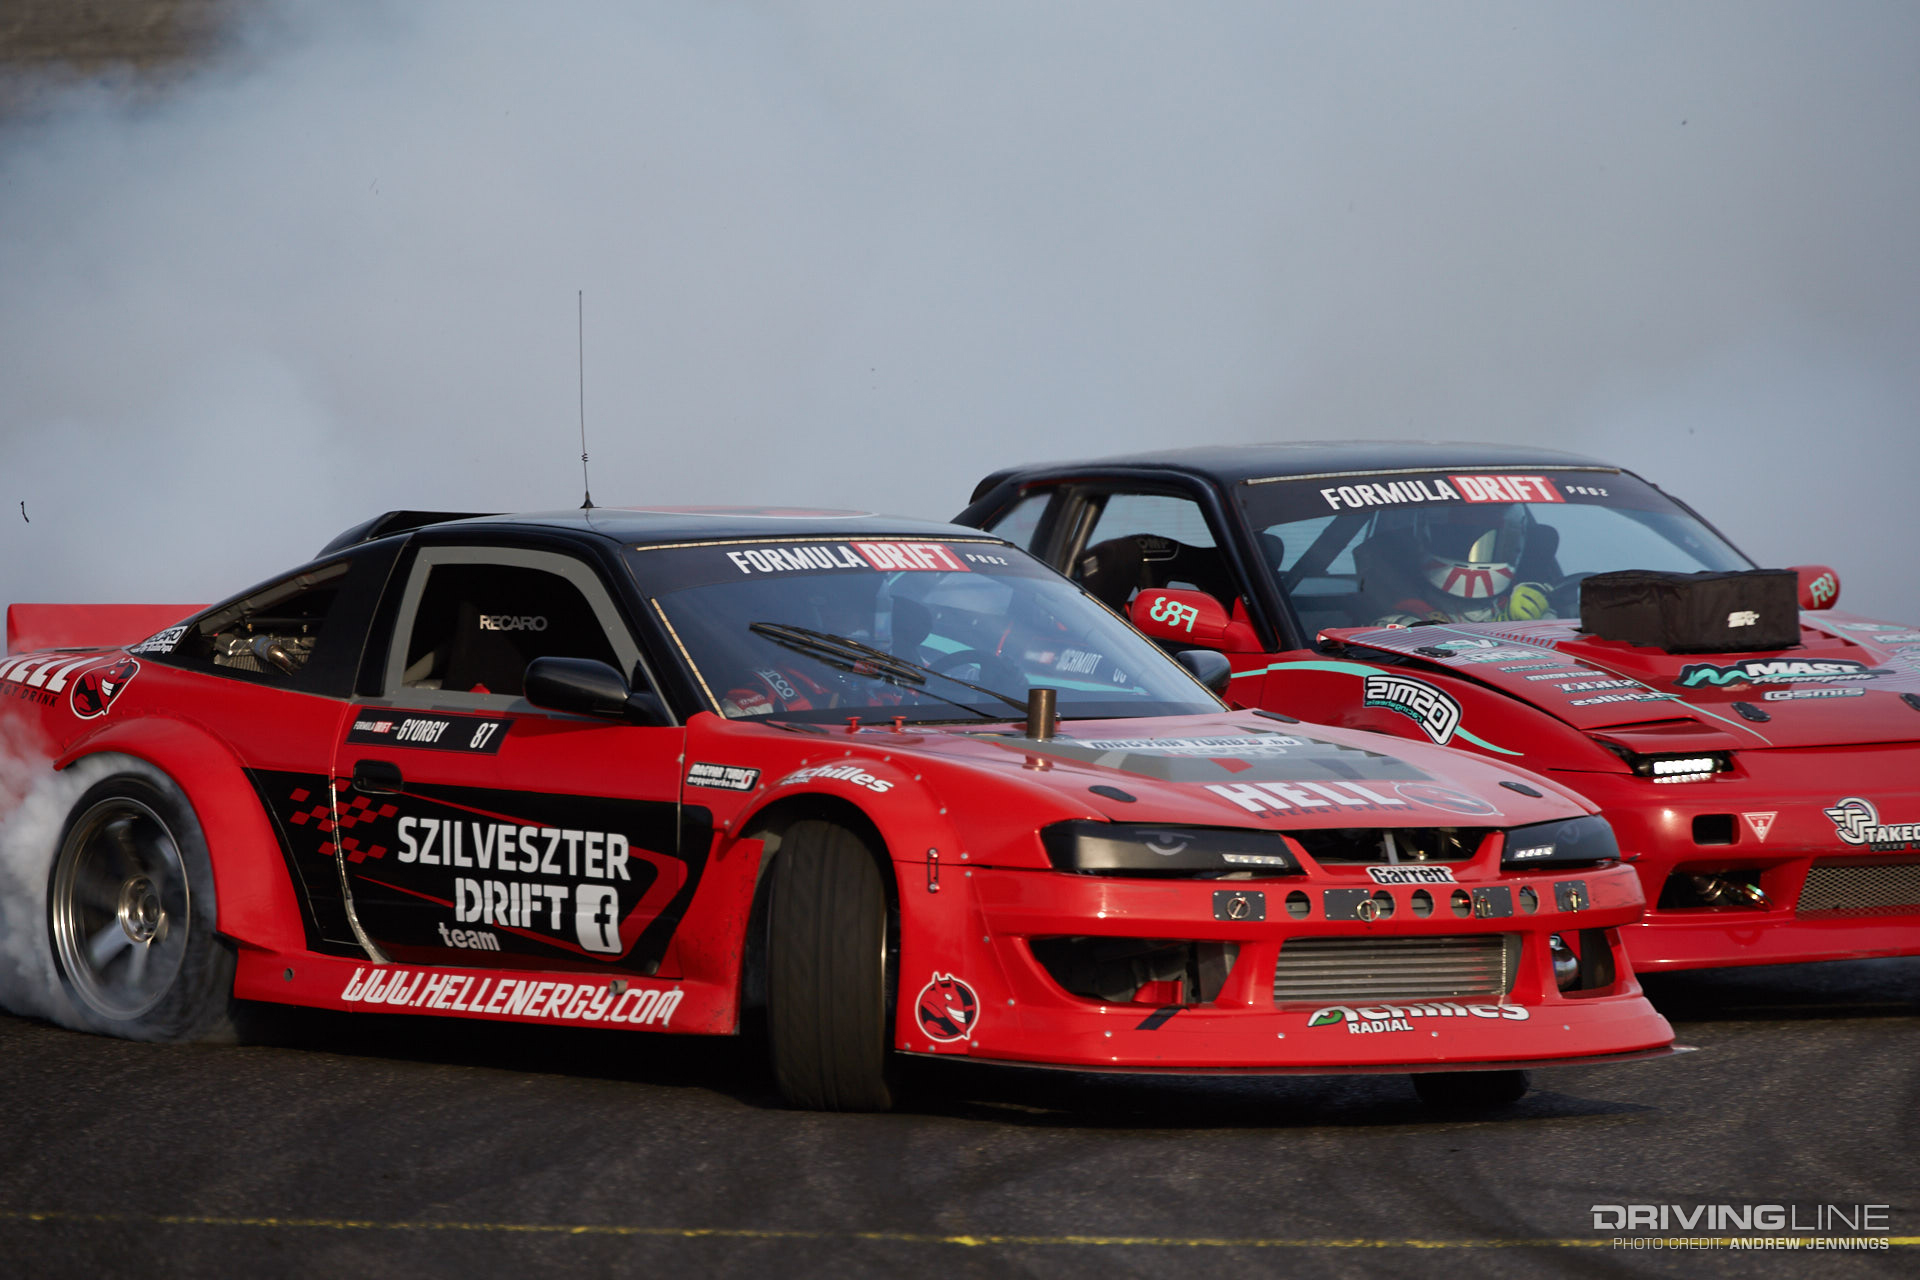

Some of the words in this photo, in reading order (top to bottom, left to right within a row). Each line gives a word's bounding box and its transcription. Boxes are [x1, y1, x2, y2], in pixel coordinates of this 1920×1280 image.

[1320, 479, 1461, 510] FORMULA
[1456, 476, 1554, 502] DRIFT
[726, 545, 869, 574] FORMULA
[857, 542, 958, 571] DRIFT
[480, 614, 548, 632] RECARO
[1746, 661, 1861, 677] MAST
[397, 718, 450, 743] GYORGY
[470, 722, 499, 749] 87
[1203, 781, 1408, 812] HELL
[1255, 804, 1344, 820] ENERGY
[1354, 803, 1420, 812] DRINK
[397, 815, 632, 881] SZILVESZTER
[1370, 867, 1455, 884] Garrett
[455, 877, 569, 931] DRIFT
[438, 921, 501, 951] team
[341, 967, 685, 1026] WWW.HELLENERGY.COM
[1308, 1002, 1530, 1028] Achilles
[1348, 1017, 1414, 1034] RADIAL
